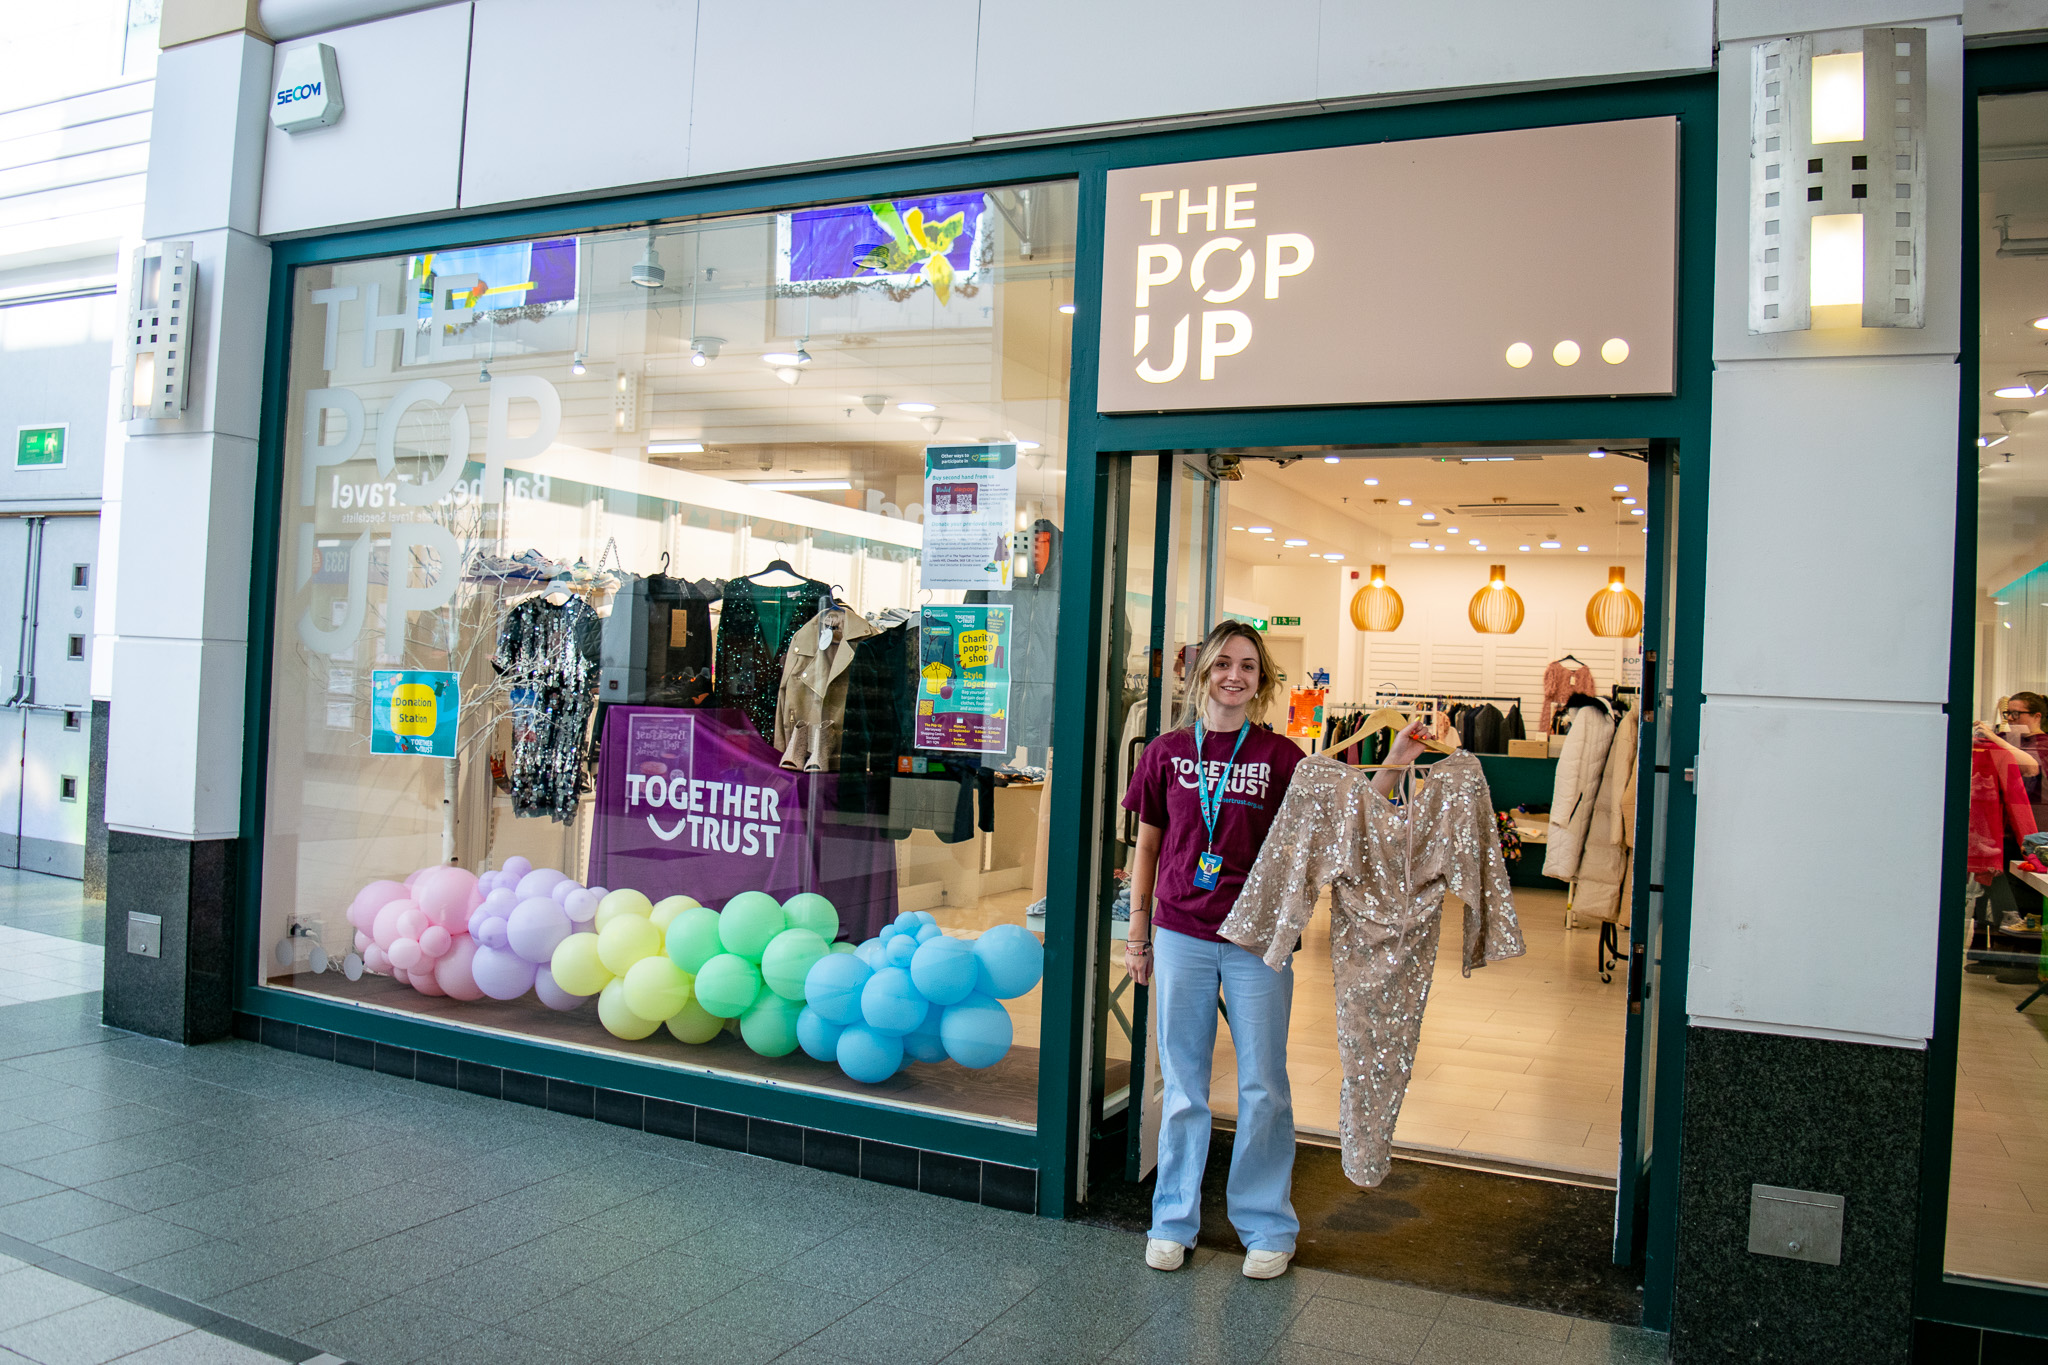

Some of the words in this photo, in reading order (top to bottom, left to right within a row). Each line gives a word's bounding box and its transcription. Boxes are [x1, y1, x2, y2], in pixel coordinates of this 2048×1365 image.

[277, 82, 322, 105] SECOM
[1140, 182, 1258, 236] THE
[1135, 232, 1315, 308] POP
[311, 272, 480, 371] THE
[1133, 309, 1254, 385] UP
[300, 374, 562, 507] POP
[296, 522, 461, 657] UP
[962, 633, 994, 643] Charity
[963, 644, 994, 655] pop-up
[969, 654, 989, 663] shop
[963, 671, 983, 680] Style
[963, 680, 997, 689] Together
[395, 697, 431, 707] Donation
[399, 713, 428, 723] Station
[1171, 756, 1271, 782] TOGETHER
[626, 773, 781, 822] TOGETHER
[686, 814, 781, 858] TRUST
